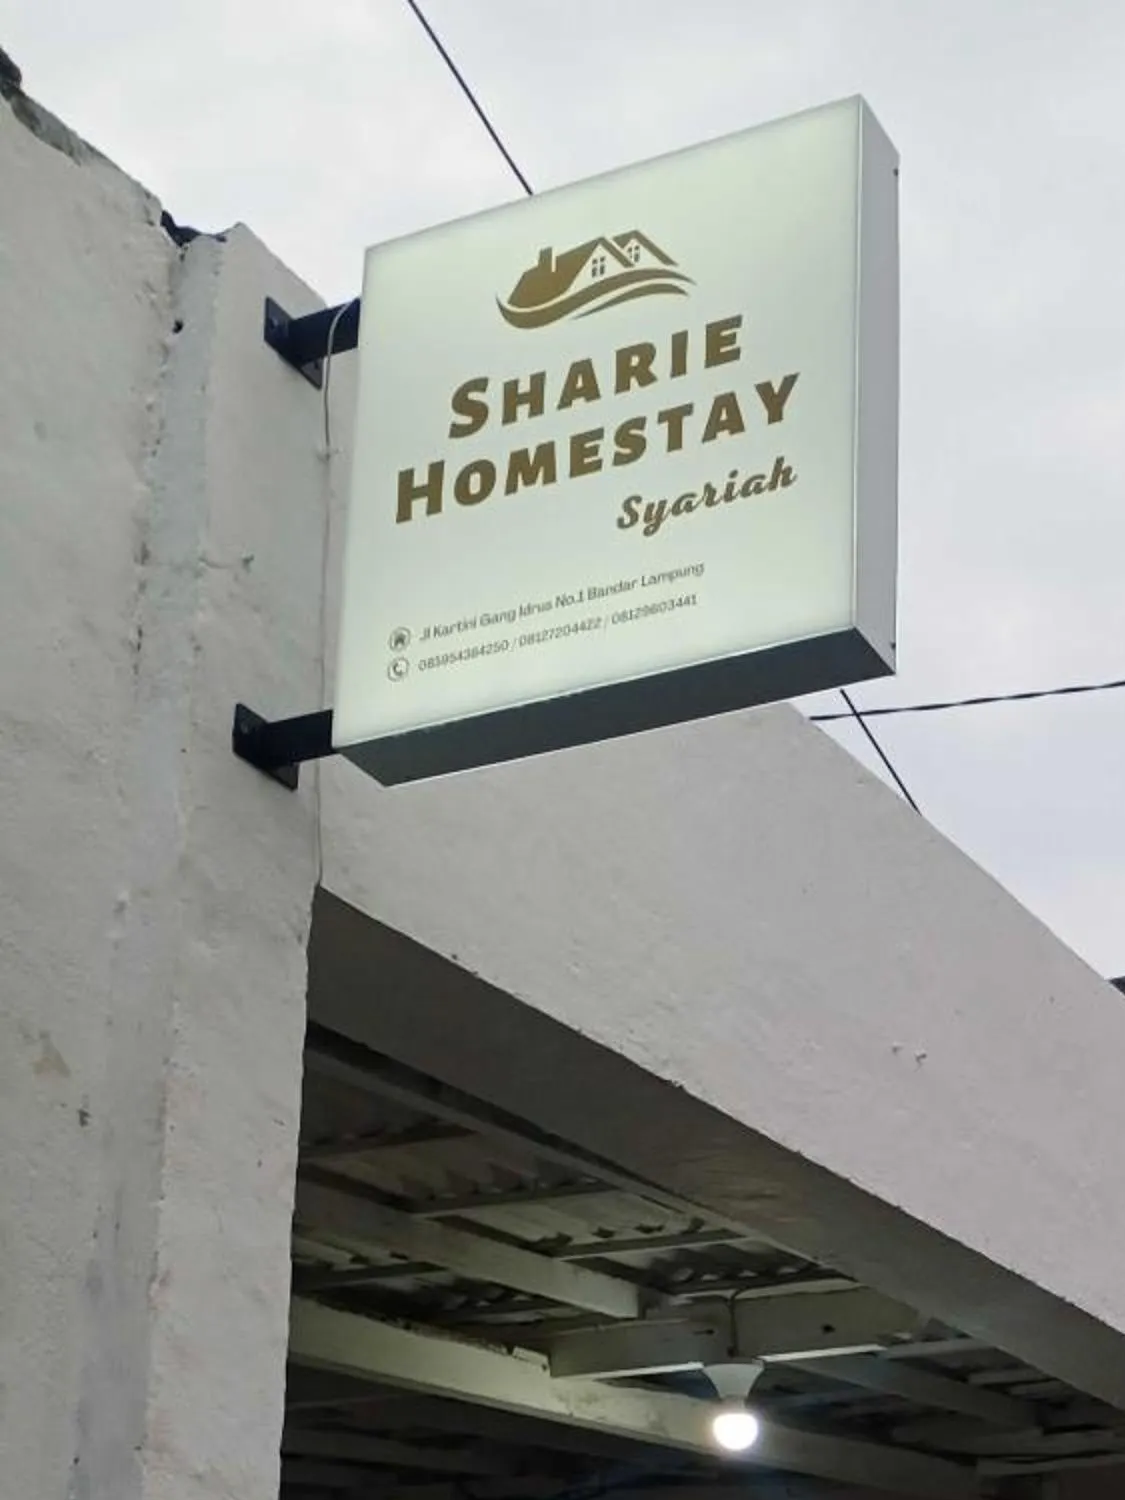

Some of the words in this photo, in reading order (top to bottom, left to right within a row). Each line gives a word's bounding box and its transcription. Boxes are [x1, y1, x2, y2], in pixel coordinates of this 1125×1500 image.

[448, 314, 743, 439] SHARIE
[395, 373, 799, 525] HOMESTAY
[617, 456, 797, 536] Syariah
[433, 615, 477, 638] Kartini
[479, 608, 517, 627] Gang
[519, 601, 553, 617] Idrus
[555, 588, 583, 609] No.1
[587, 579, 637, 601] Bandar
[640, 562, 705, 587] Lampung
